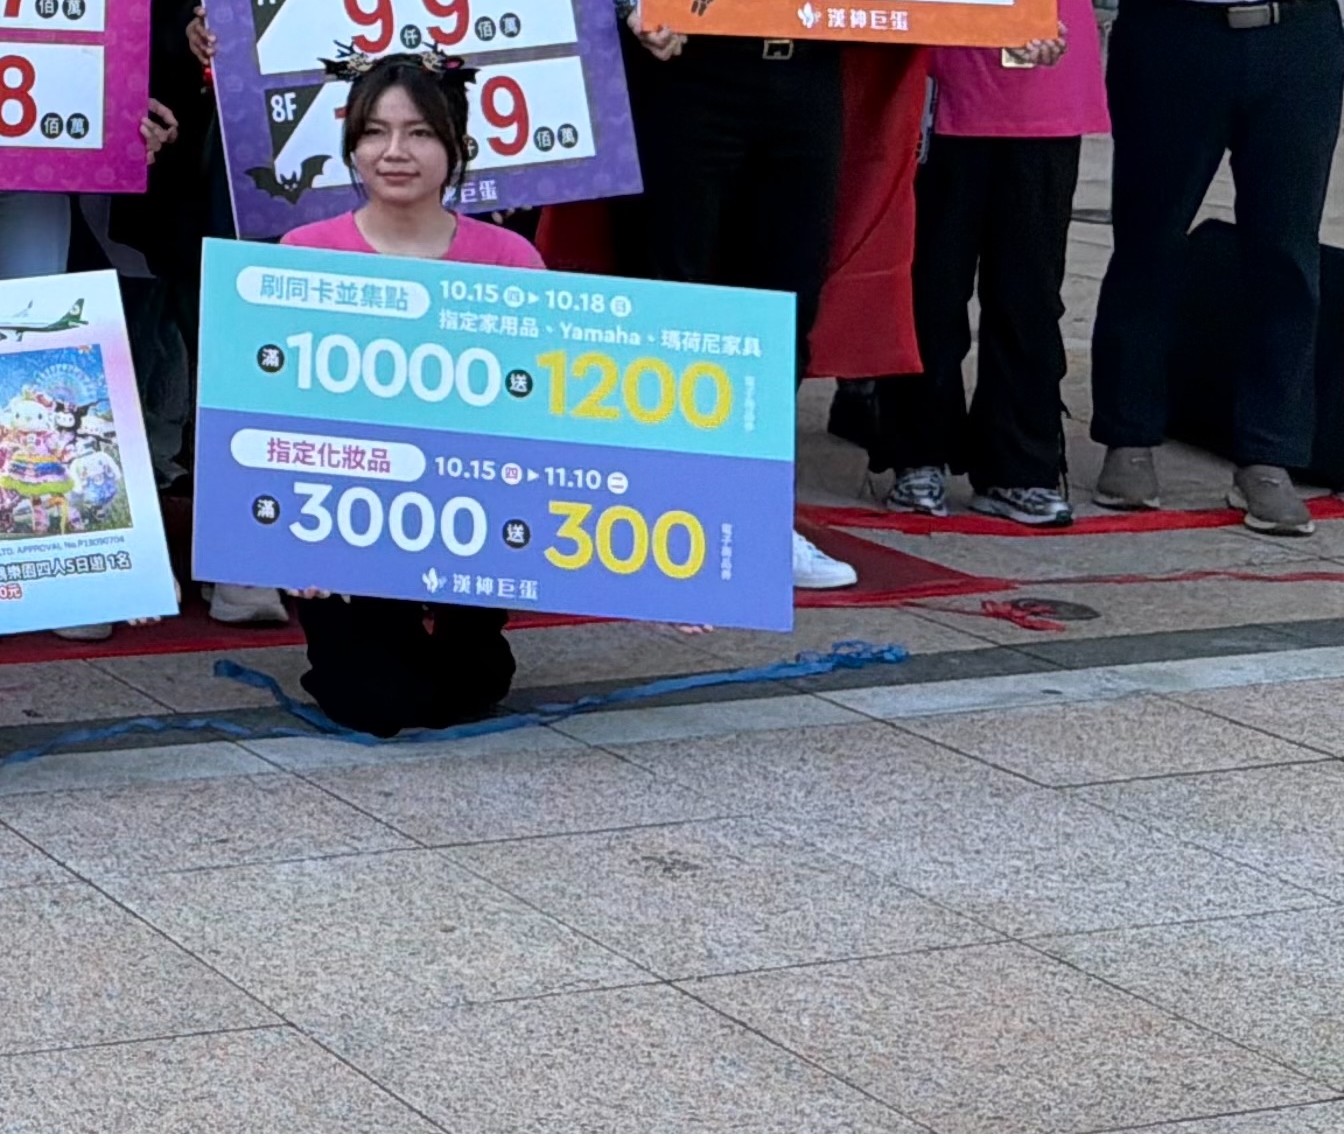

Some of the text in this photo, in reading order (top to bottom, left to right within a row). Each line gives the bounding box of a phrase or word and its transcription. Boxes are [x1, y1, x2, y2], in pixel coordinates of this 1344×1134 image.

[827, 7, 909, 32] 漢神巨蛋
[271, 92, 297, 123] 8F
[259, 272, 409, 313] 刷同卡並集點
[267, 437, 391, 474] 指定化妝品
[453, 574, 538, 601] 漢神巨蛋
